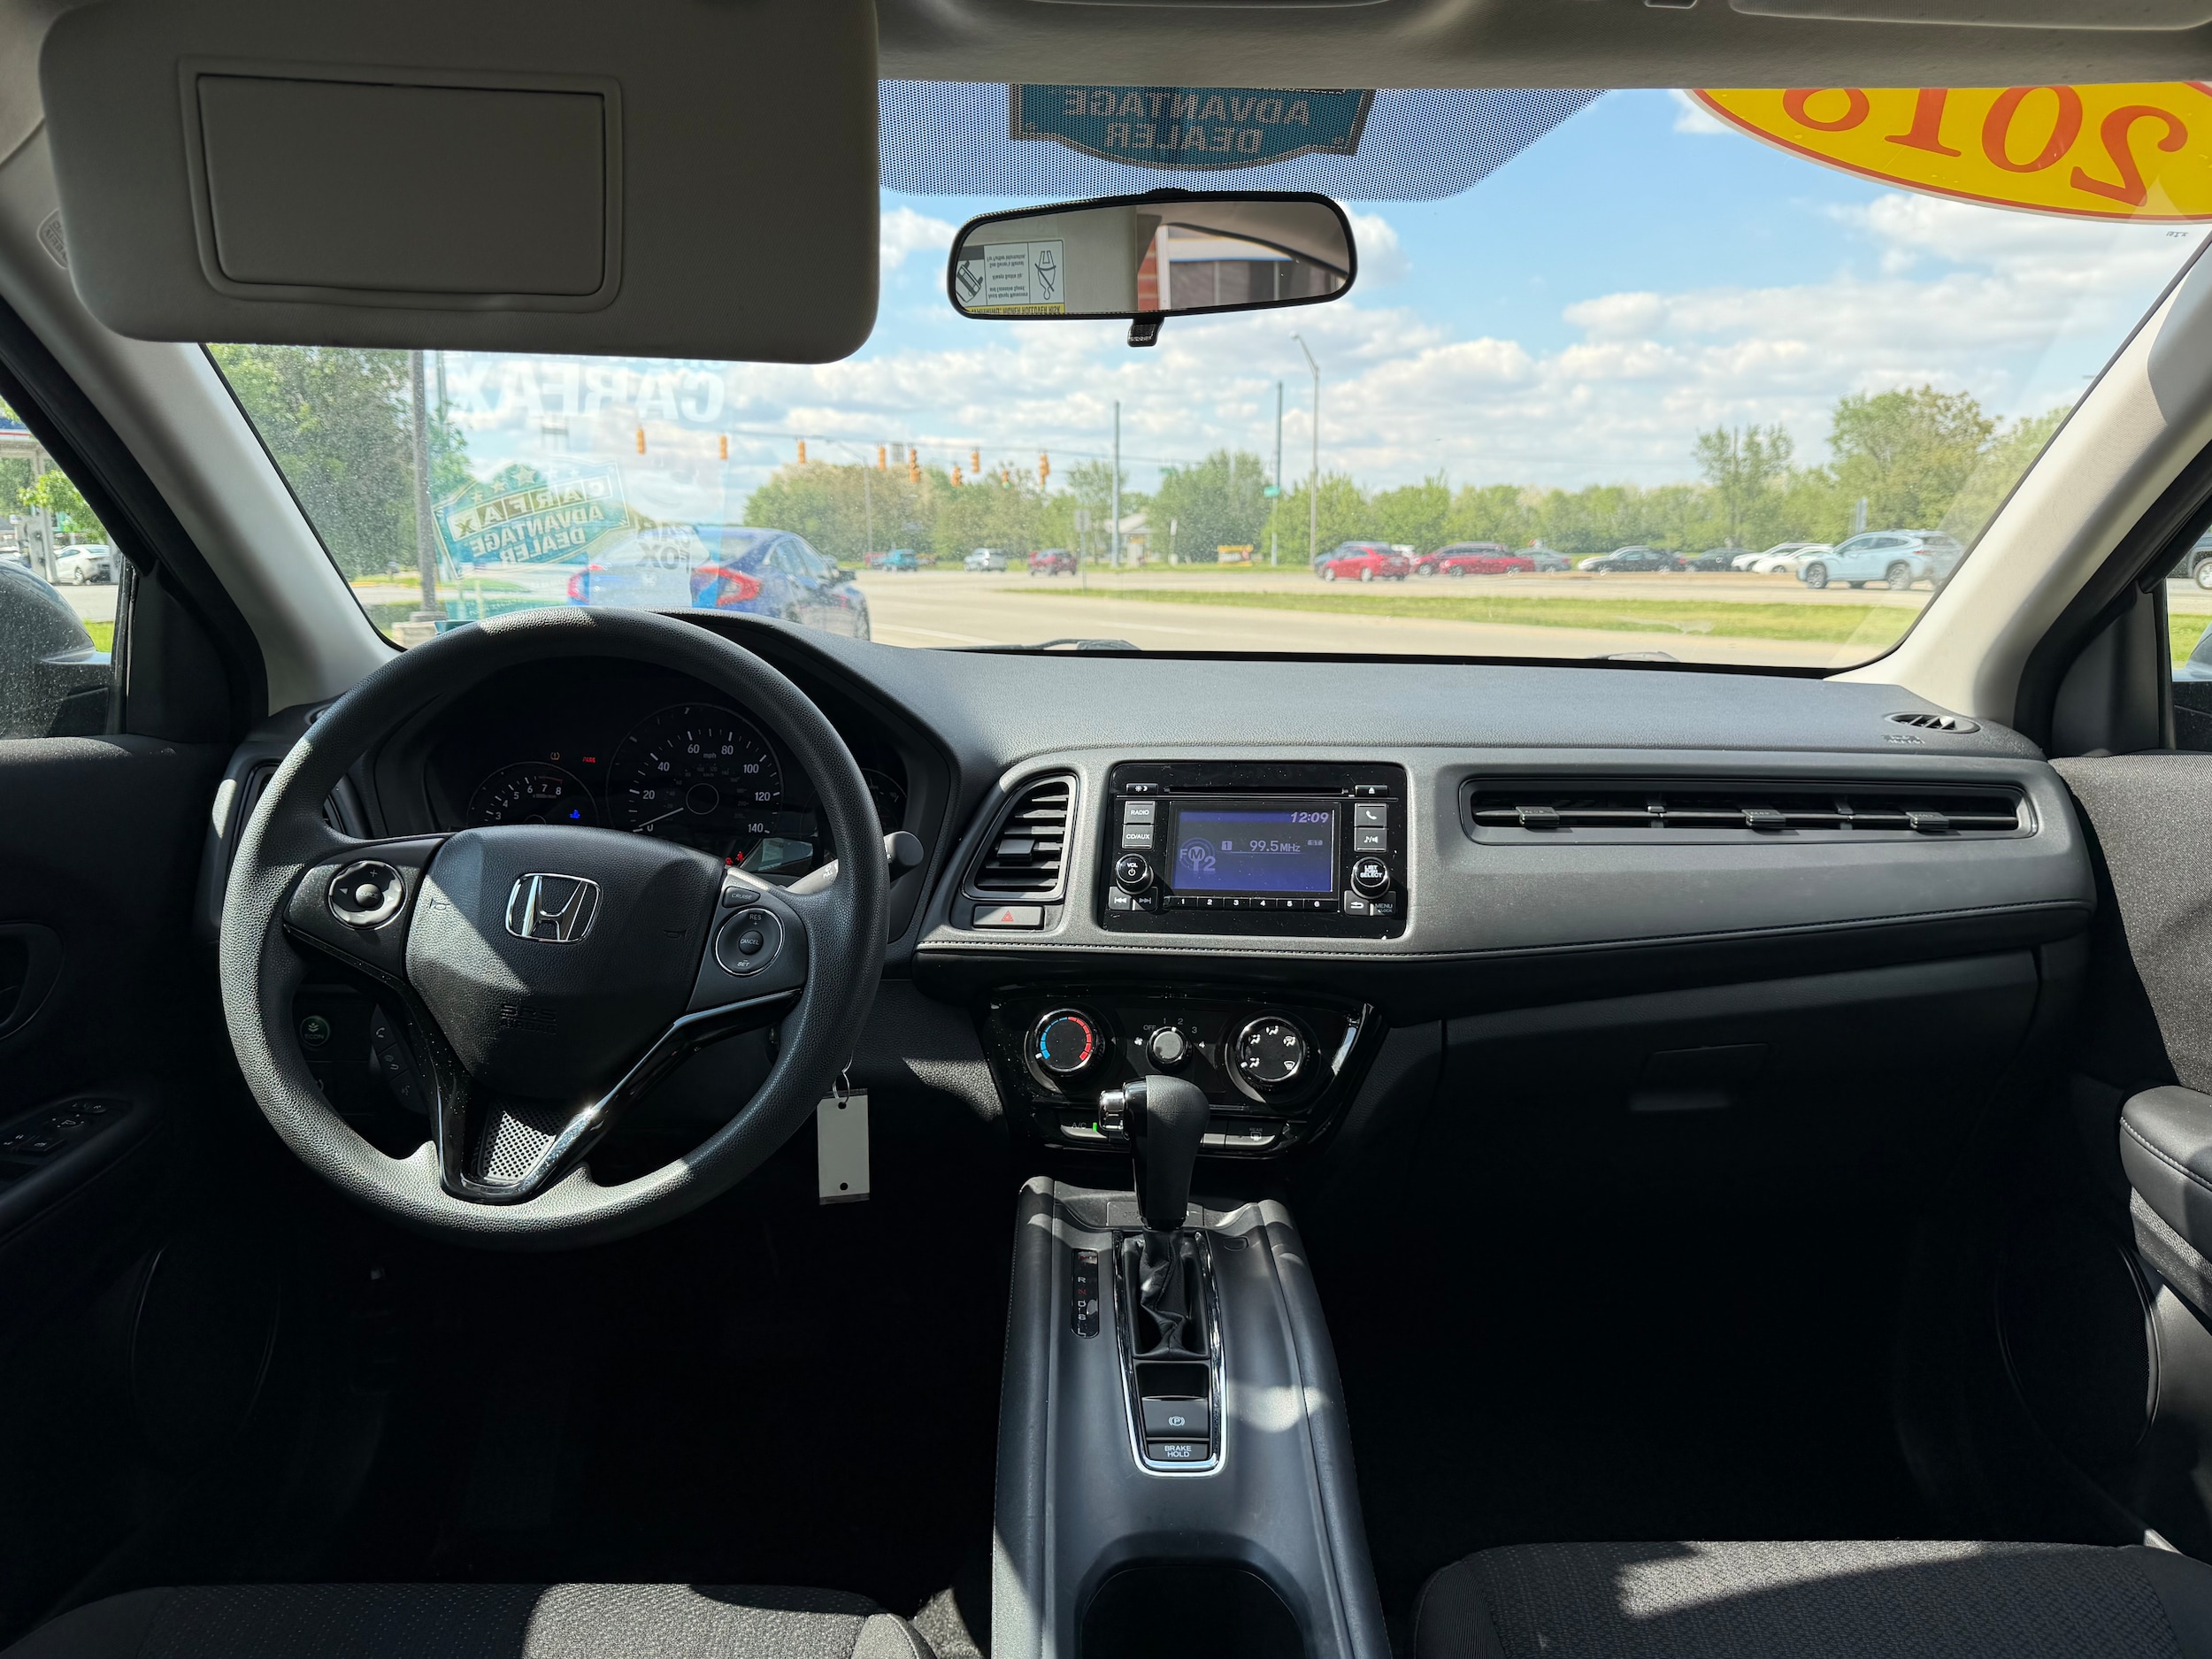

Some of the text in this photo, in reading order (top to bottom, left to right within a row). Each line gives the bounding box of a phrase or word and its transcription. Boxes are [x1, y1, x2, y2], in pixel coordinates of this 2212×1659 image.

[687, 744, 700, 754] 60
[721, 745, 733, 755] 80
[657, 762, 670, 772] 40
[743, 764, 759, 773] 100
[526, 785, 533, 794] 6
[556, 787, 561, 795] 8
[513, 791, 519, 800] 5
[642, 790, 655, 800] 20
[755, 791, 771, 802] 120
[495, 811, 502, 820] 3
[1290, 811, 1329, 823] 12:09
[748, 823, 764, 833] 140
[1249, 840, 1279, 852] 99.5
[1279, 843, 1301, 852] MHz
